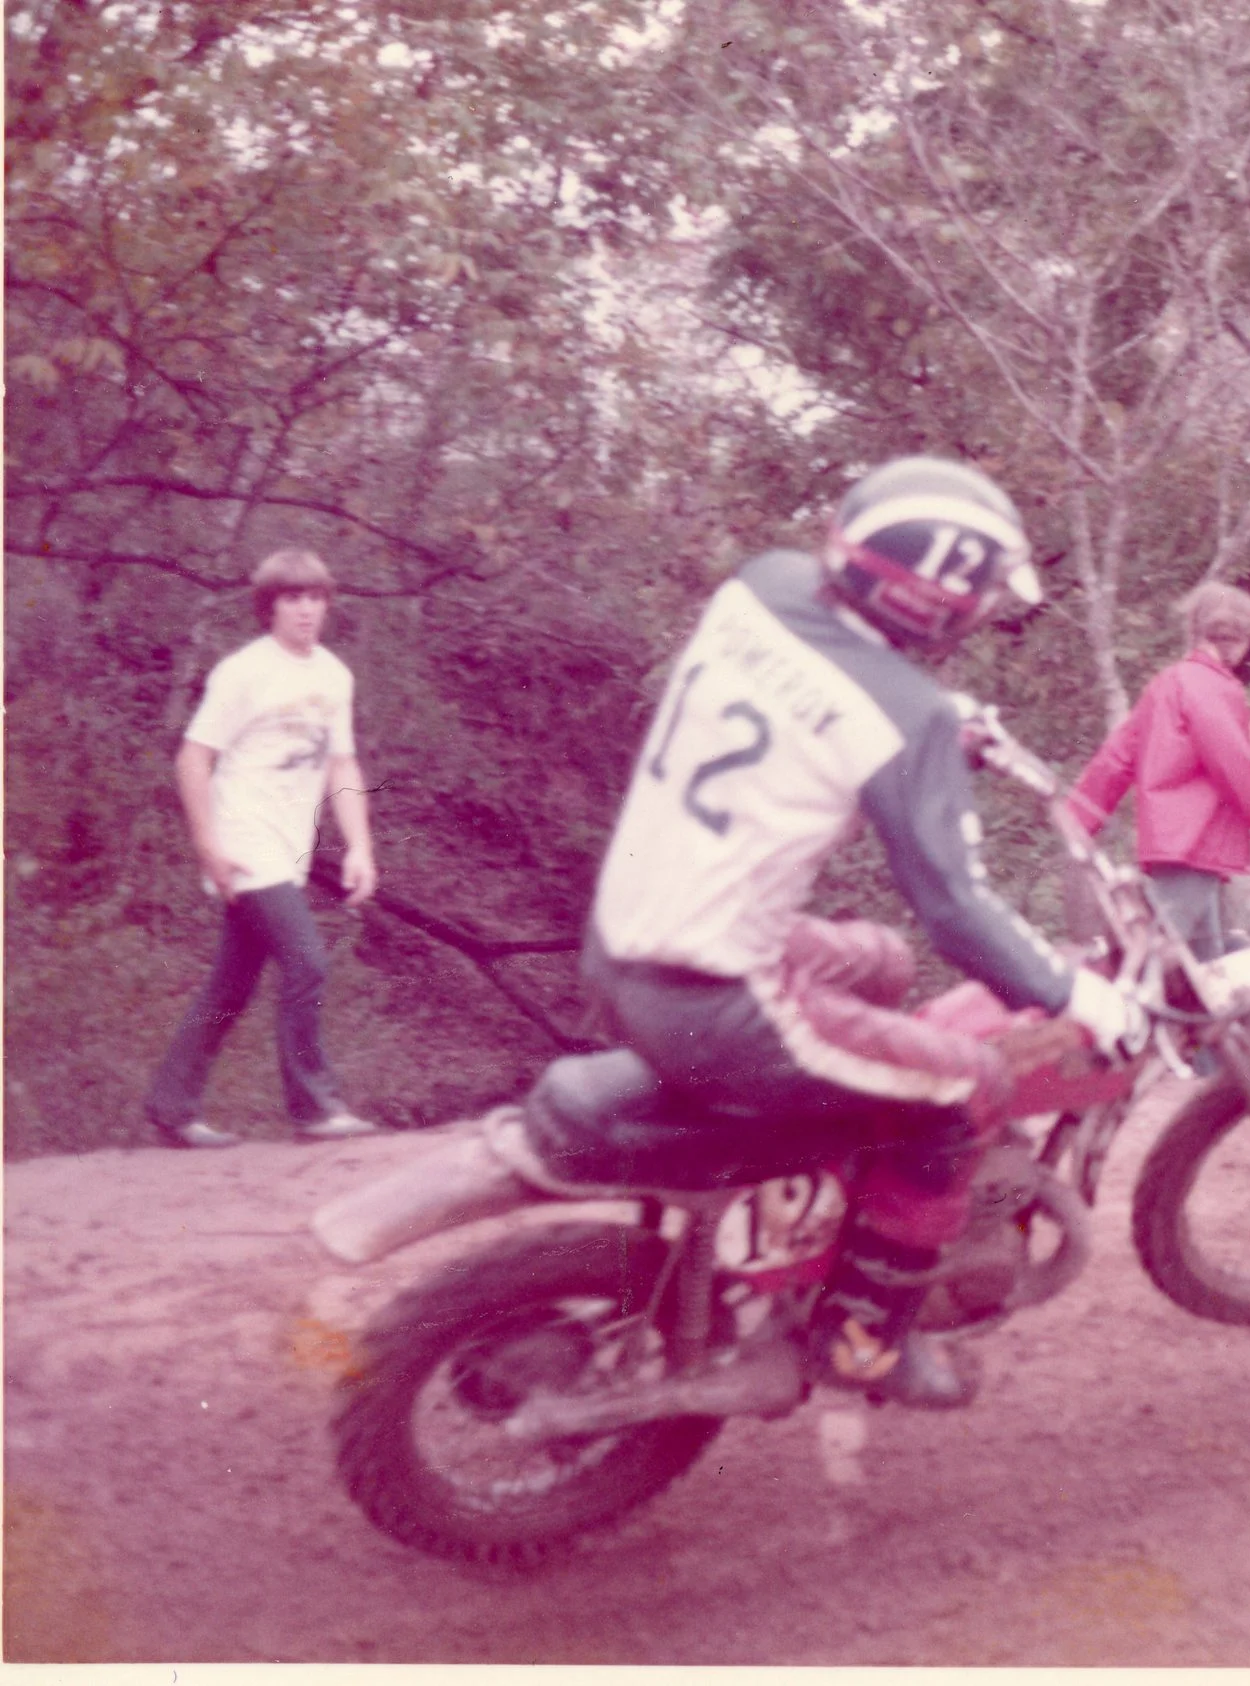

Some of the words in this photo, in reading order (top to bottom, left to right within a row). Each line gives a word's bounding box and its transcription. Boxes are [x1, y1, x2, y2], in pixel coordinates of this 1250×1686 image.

[914, 526, 986, 595] 12
[650, 661, 773, 837] 12
[743, 1174, 828, 1264] 12
